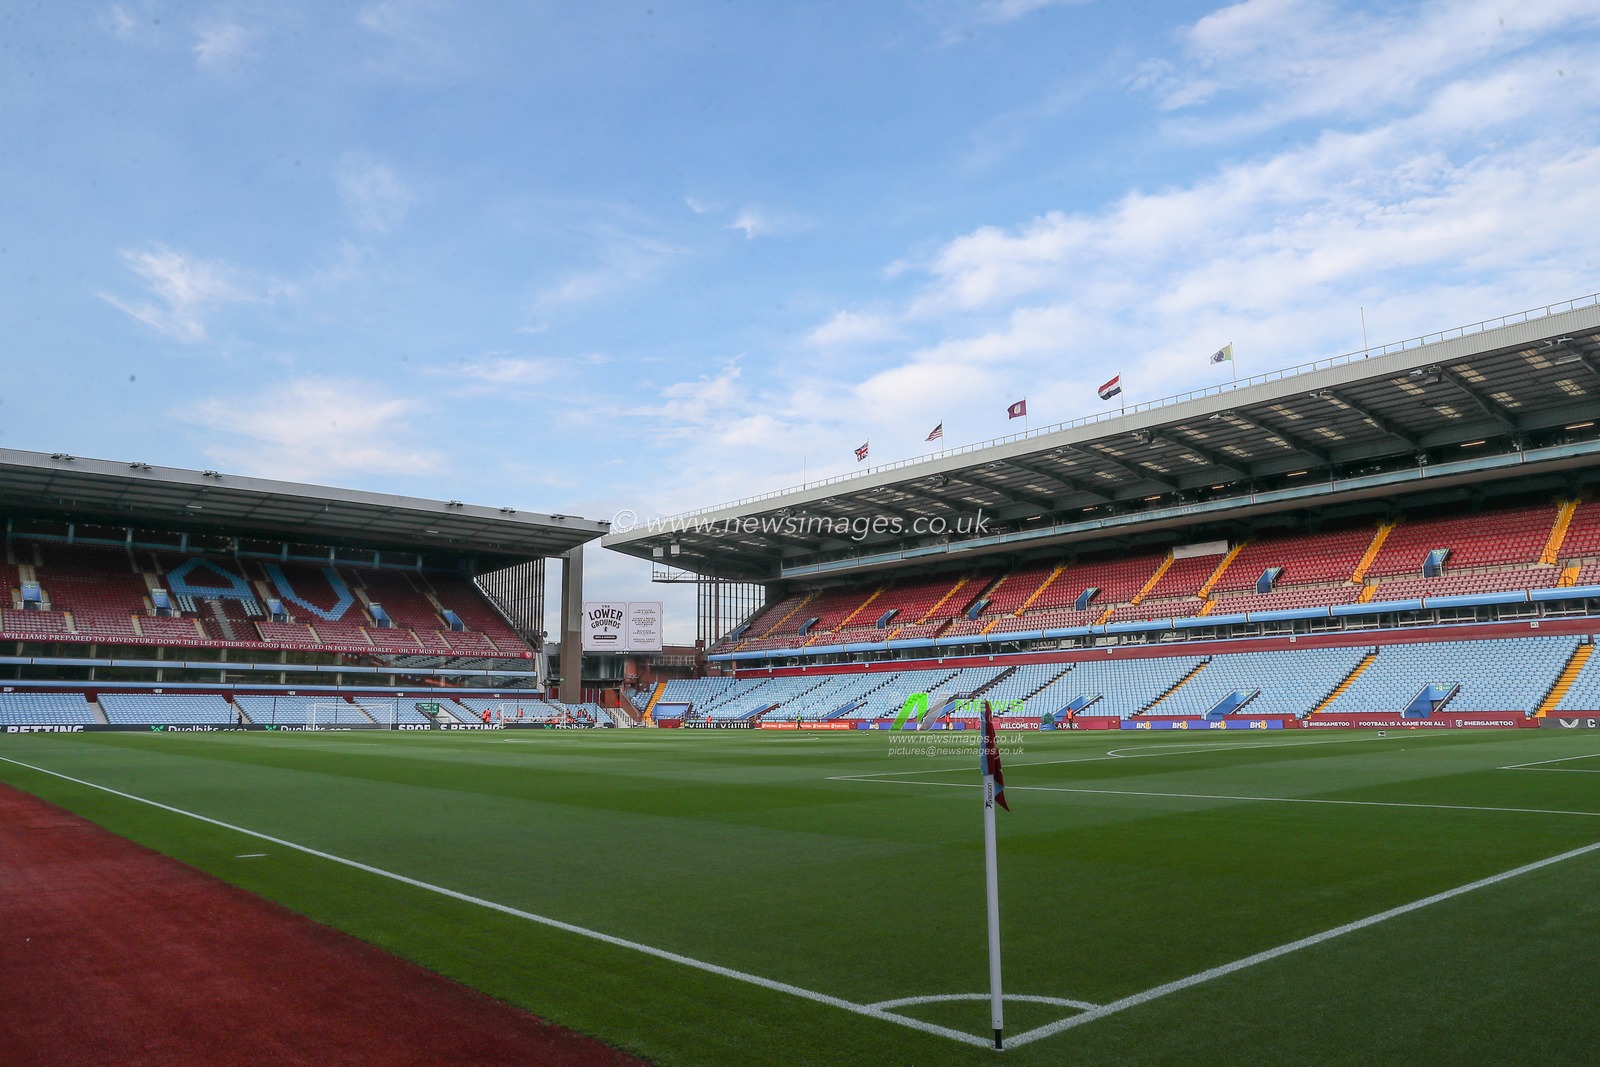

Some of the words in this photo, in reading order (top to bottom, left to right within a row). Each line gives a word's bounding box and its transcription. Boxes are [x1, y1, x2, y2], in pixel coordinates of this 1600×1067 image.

[588, 608, 623, 621] LOWER
[590, 619, 621, 629] GROUNDS
[3, 632, 47, 640] WILLIAMS
[49, 634, 92, 642] PREPARED
[1136, 721, 1151, 730] BK8
[1172, 720, 1188, 730] BK8
[1210, 720, 1227, 730] BK8
[1250, 720, 1267, 730] BK8
